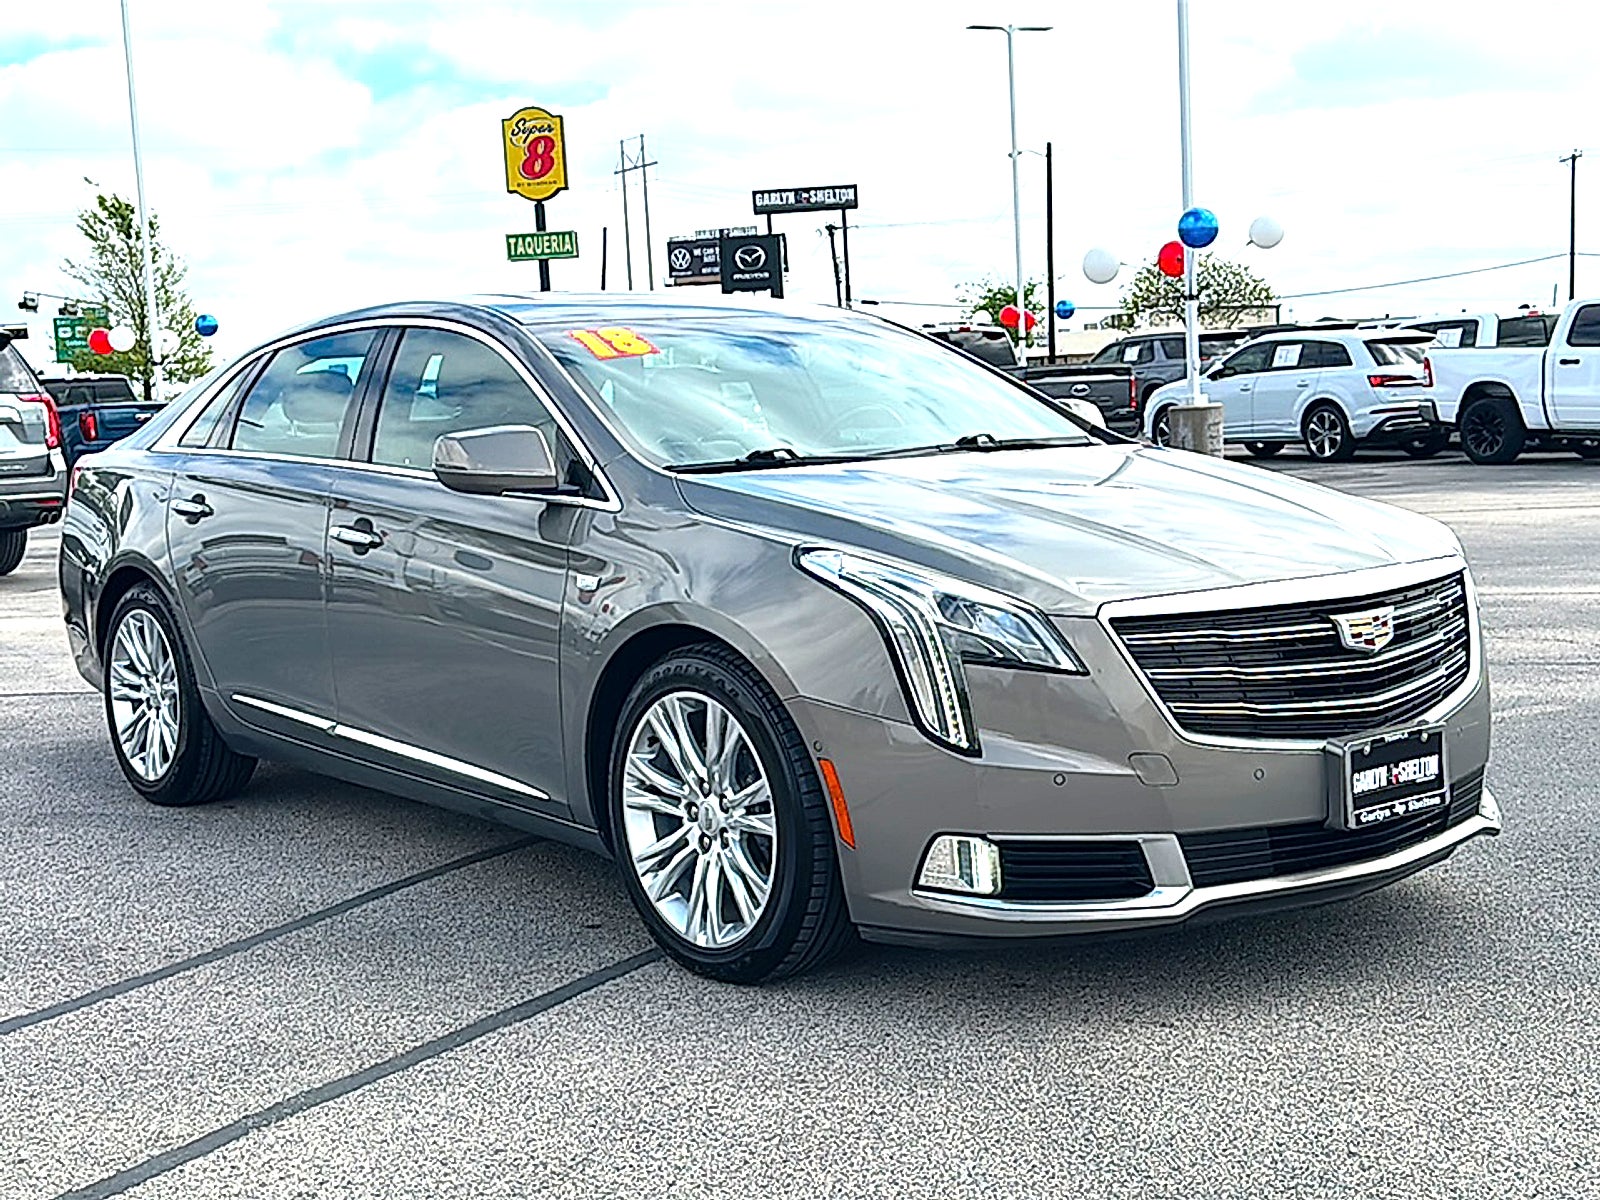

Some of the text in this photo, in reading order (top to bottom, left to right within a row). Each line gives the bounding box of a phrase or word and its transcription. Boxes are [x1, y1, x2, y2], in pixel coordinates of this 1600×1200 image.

[511, 118, 554, 144] Super
[519, 135, 556, 180] 8
[810, 188, 855, 203] SHELTON
[508, 234, 573, 256] TAQUERIA
[568, 326, 653, 358] 18
[1398, 754, 1439, 782] SHELTON
